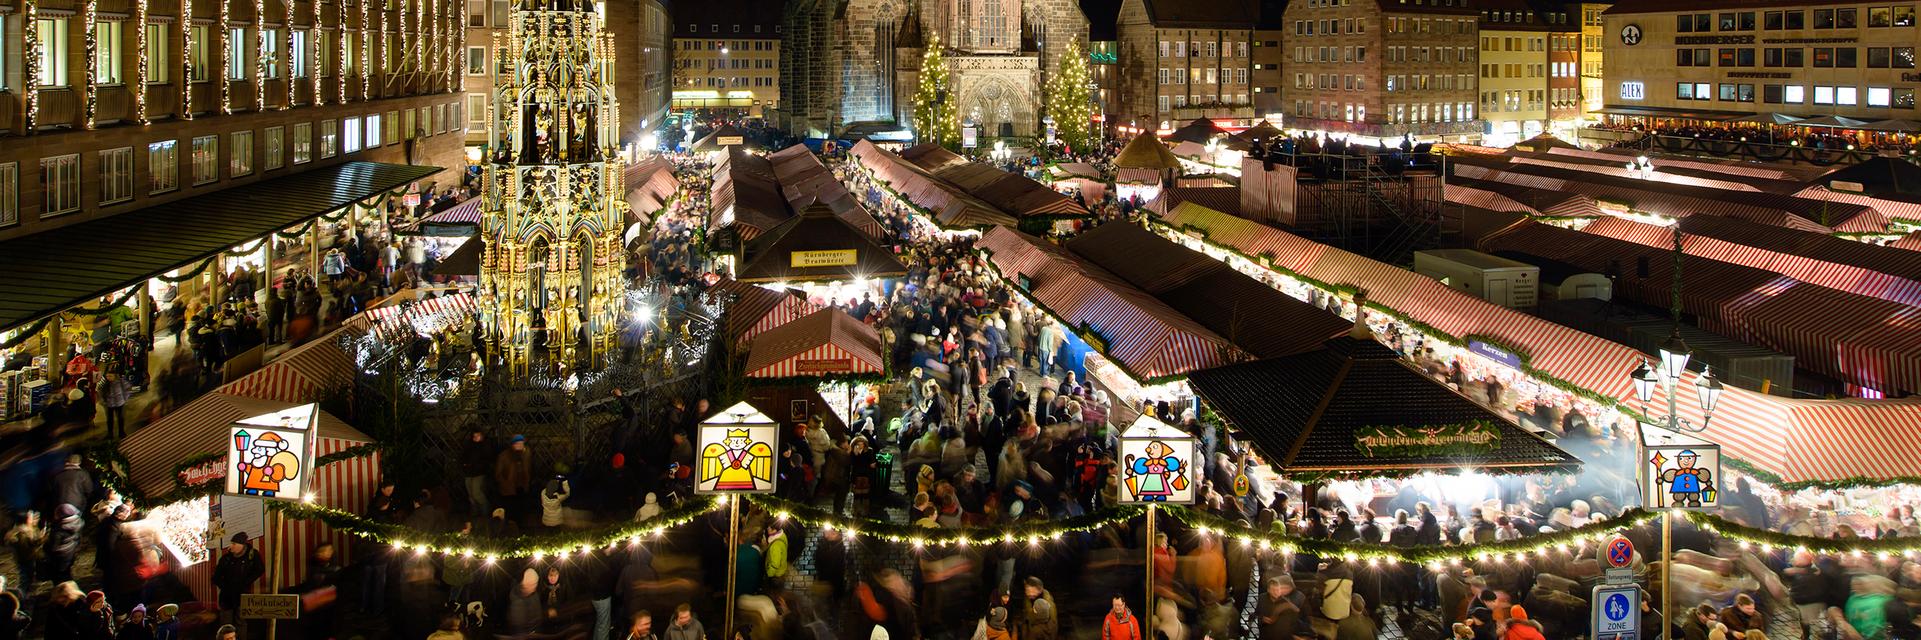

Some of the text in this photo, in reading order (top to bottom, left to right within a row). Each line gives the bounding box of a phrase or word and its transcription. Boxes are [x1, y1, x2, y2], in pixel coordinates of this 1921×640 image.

[1621, 83, 1642, 98] ALEX
[1482, 343, 1507, 359] Kerzen
[1607, 621, 1627, 630] ZONE
